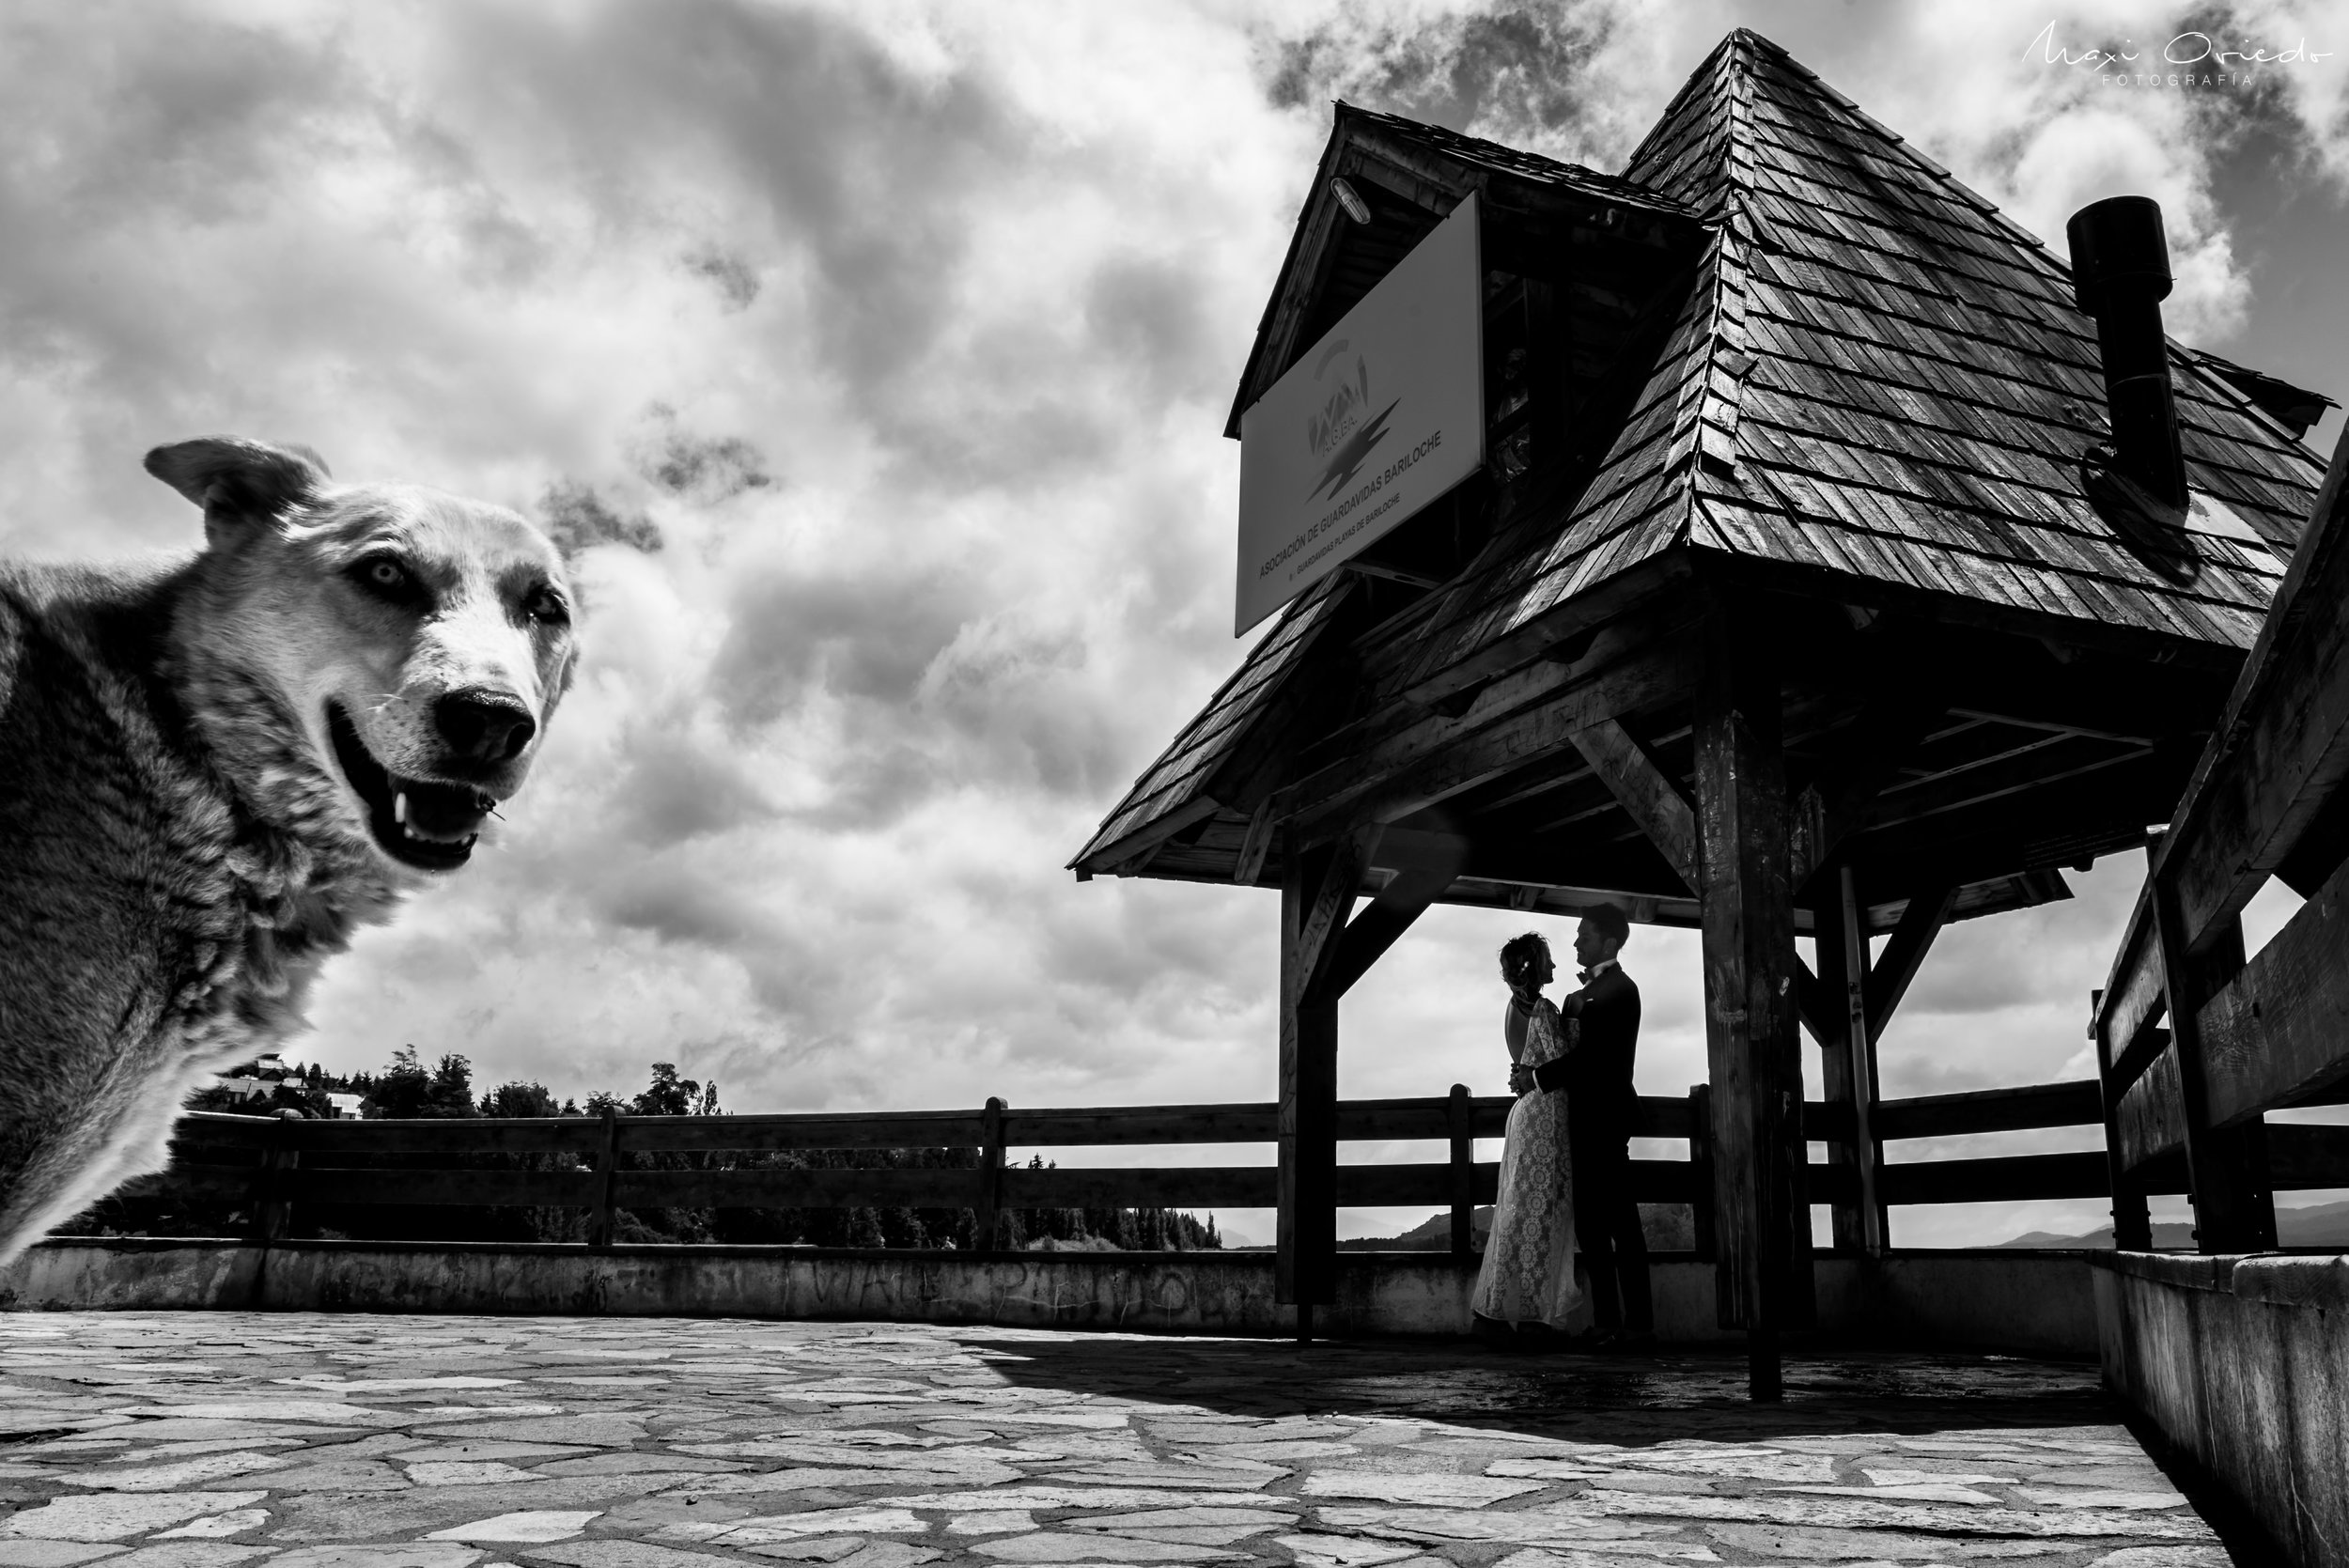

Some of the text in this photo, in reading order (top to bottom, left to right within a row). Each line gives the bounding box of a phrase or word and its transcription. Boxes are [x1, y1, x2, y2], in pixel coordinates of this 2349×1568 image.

[1259, 429, 1442, 580] ASOCIACIÓN DE GUARDAVIDAS BARILOCHE
[1297, 492, 1401, 575] GUARDAVIDAS PLAYAS DE BARILOCHE
